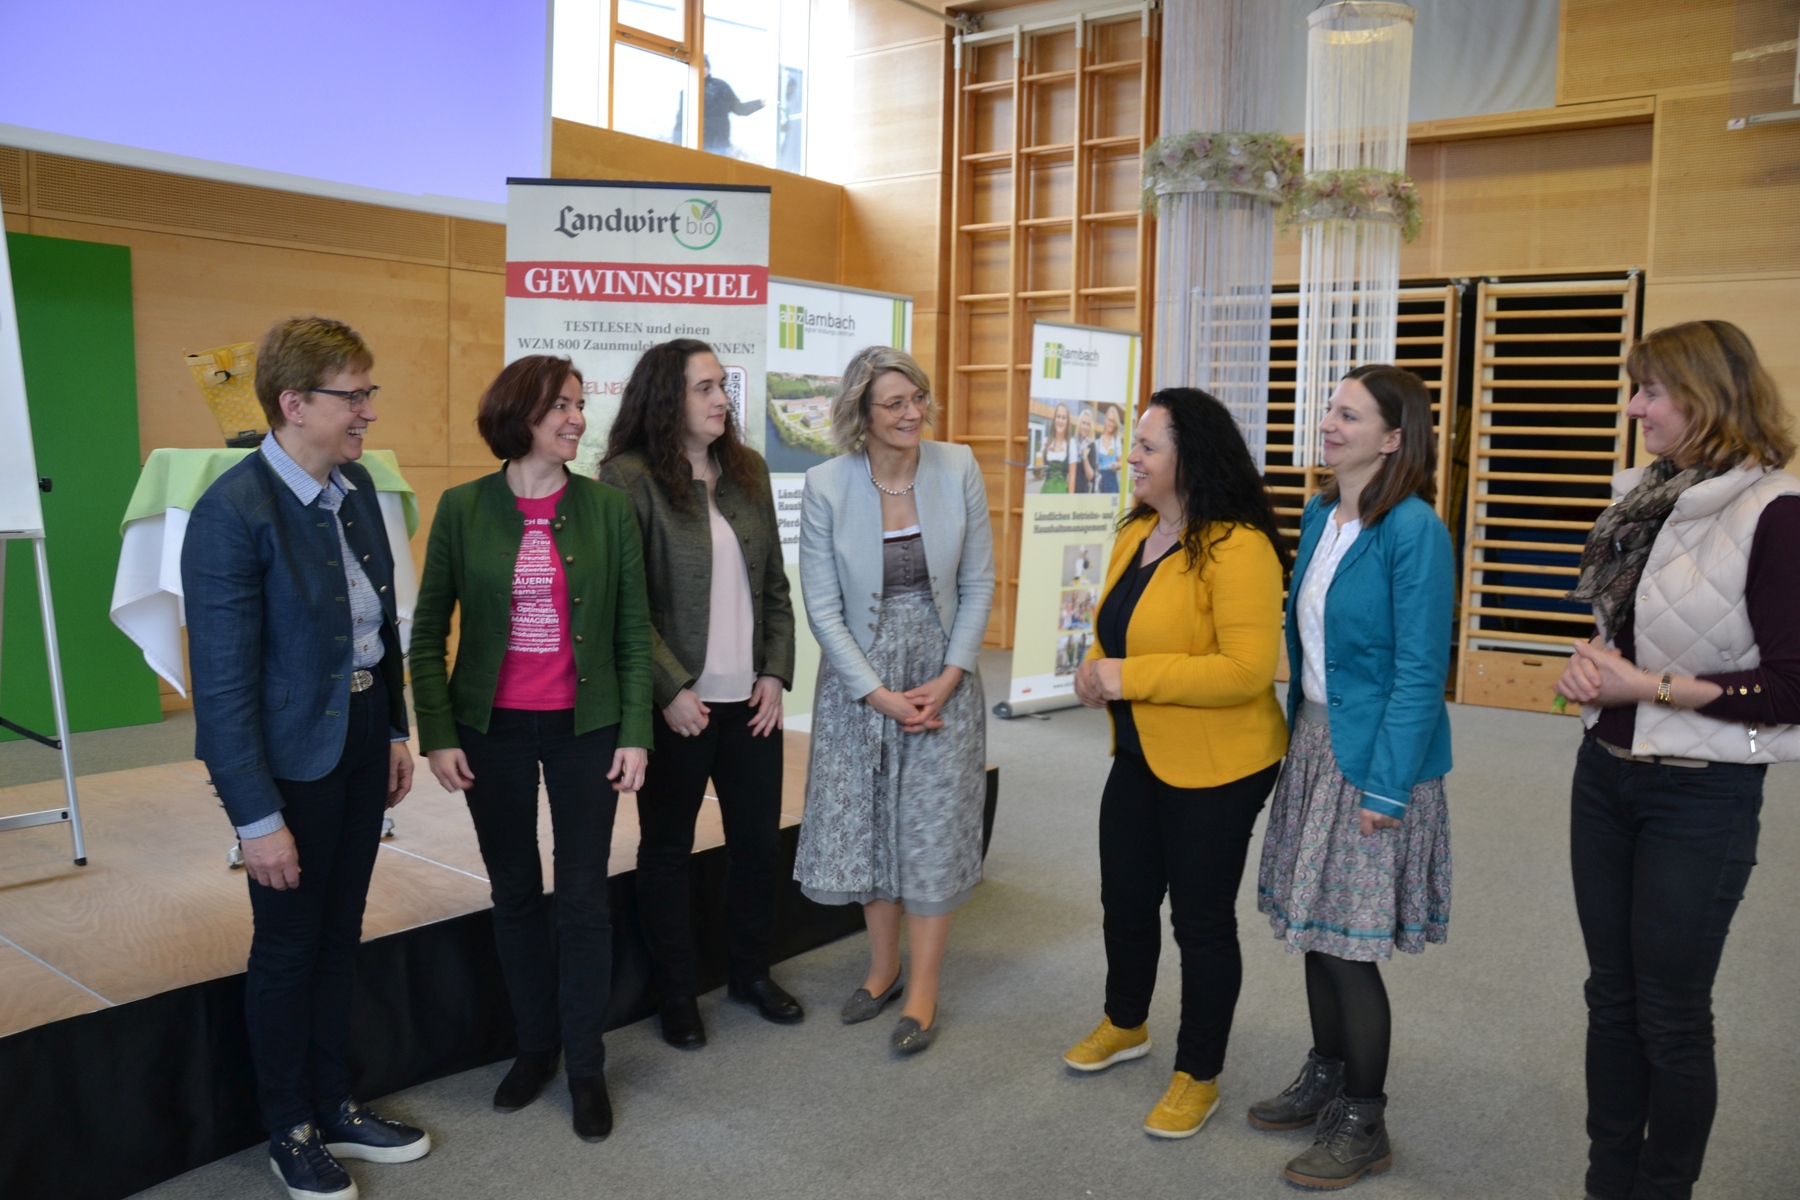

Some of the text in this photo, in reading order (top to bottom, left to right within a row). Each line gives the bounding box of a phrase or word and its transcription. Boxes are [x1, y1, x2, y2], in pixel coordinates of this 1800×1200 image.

[554, 204, 716, 238] Landwirt bio
[524, 267, 757, 299] GEWINNSPIEL
[563, 320, 710, 336] TESTLESEN und einen
[518, 337, 554, 349] WZM
[557, 338, 580, 350] 800
[516, 605, 557, 613] Optimistin
[510, 615, 559, 624] MANAGERIN
